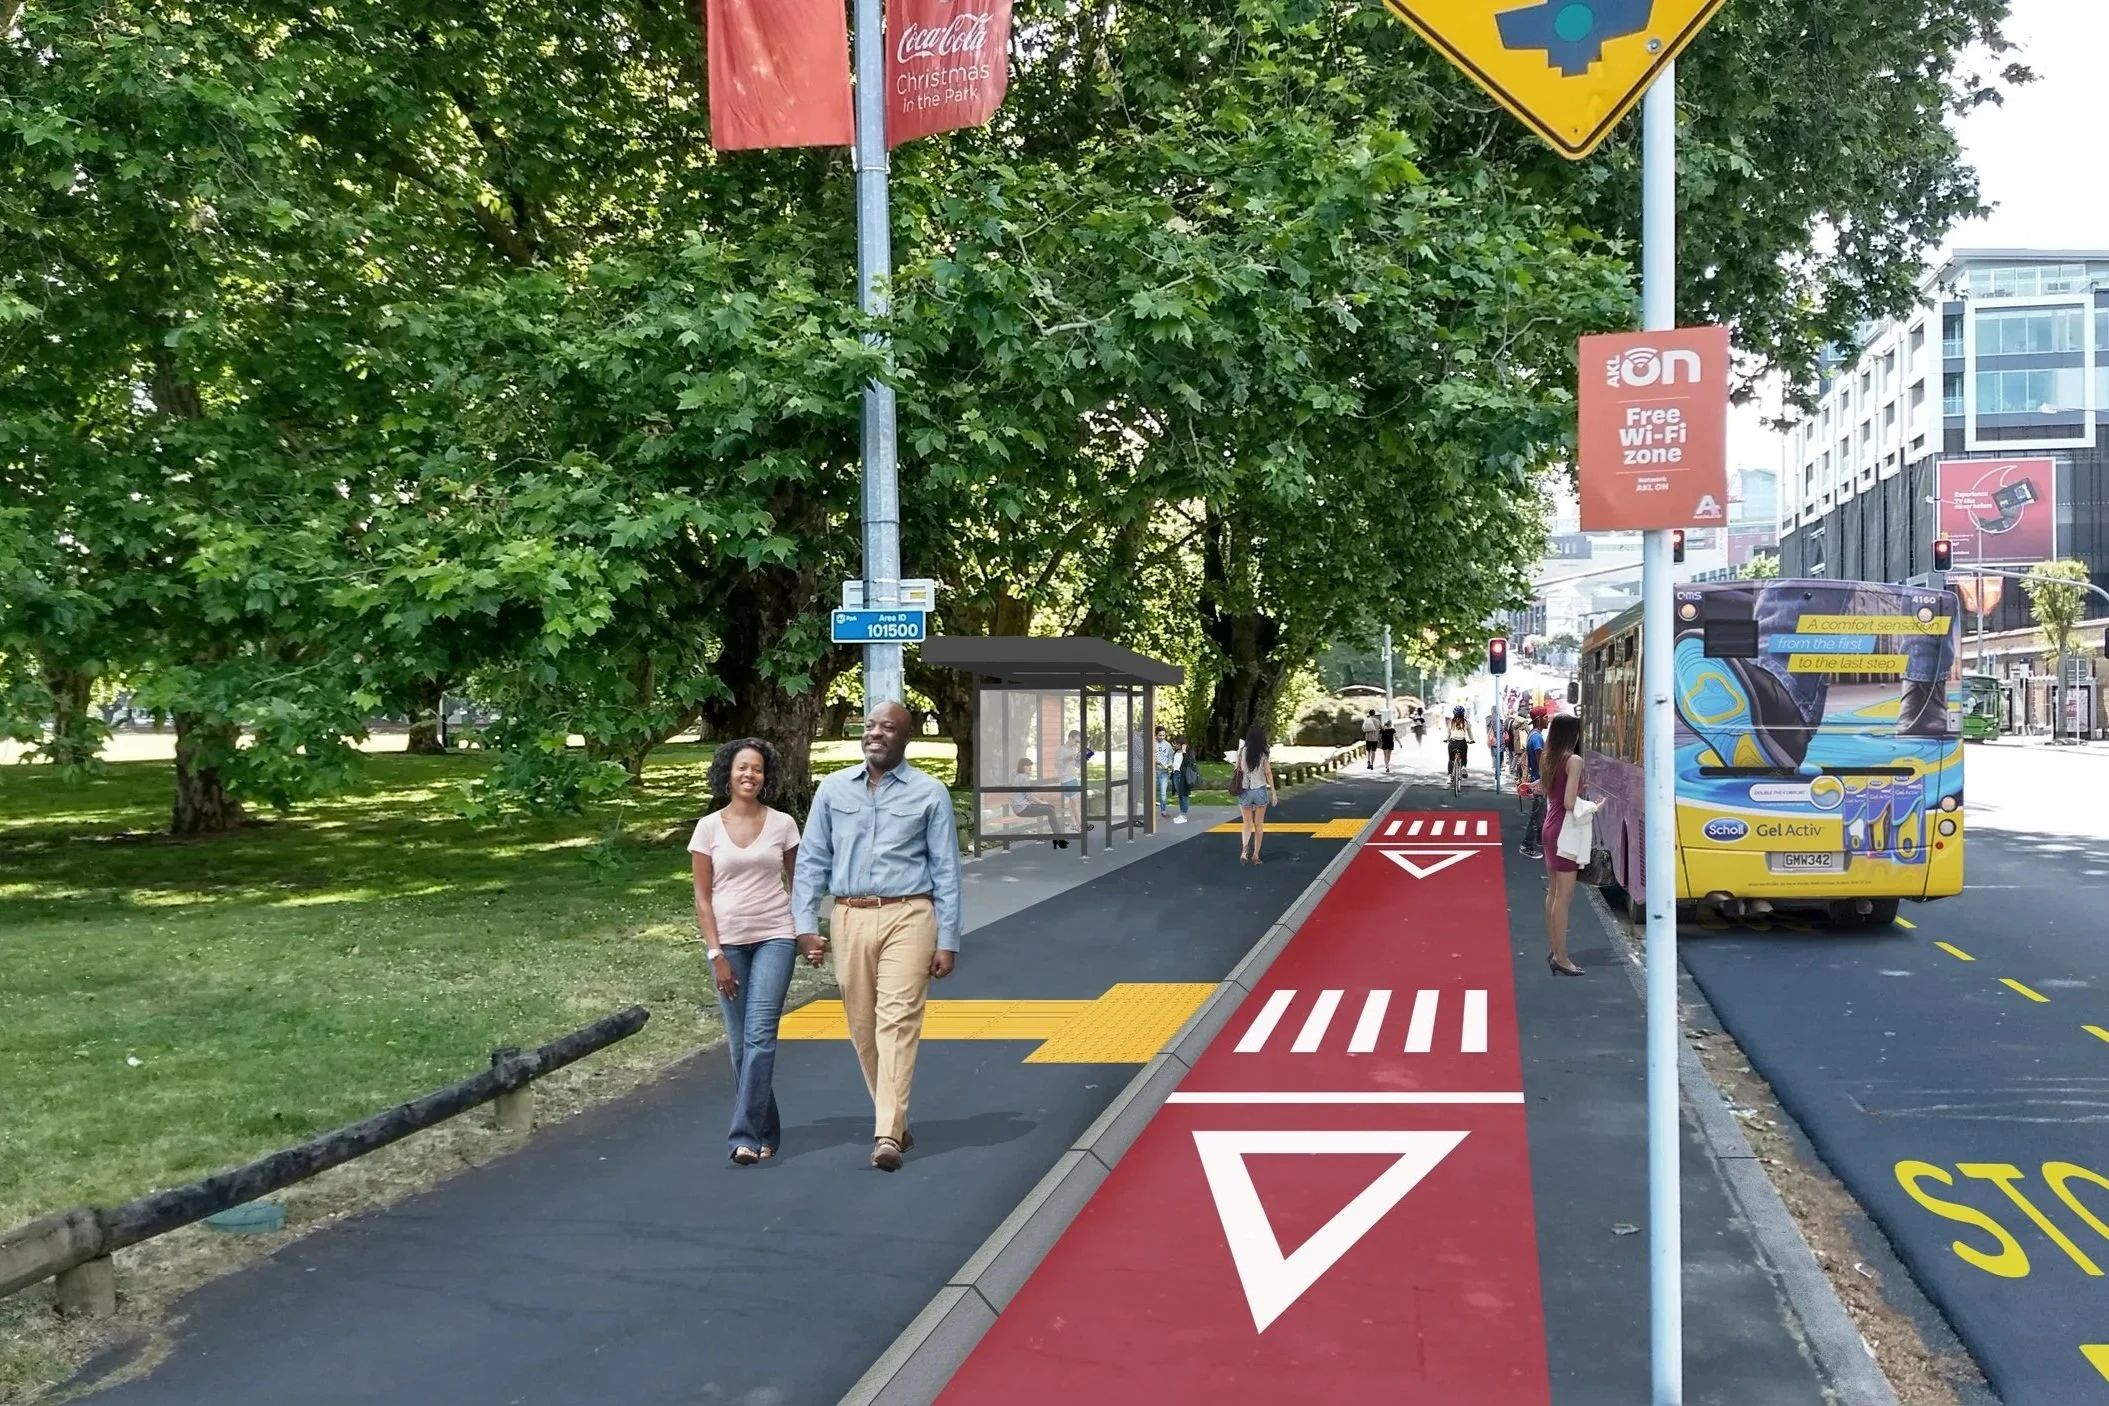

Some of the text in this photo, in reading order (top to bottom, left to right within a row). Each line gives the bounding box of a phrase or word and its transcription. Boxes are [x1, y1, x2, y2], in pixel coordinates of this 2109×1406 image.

[897, 64, 990, 95] Christmas
[903, 84, 978, 113] in the Park
[1606, 355, 1620, 388] AKL
[1626, 407, 1681, 426] Free
[1619, 423, 1687, 446] Wi-Fi
[1624, 447, 1682, 465] zone
[1912, 595, 1936, 604] 4160
[879, 614, 896, 622] Area
[1807, 618, 1940, 631] A comfort sensation
[867, 623, 918, 638] 101500
[1777, 637, 1863, 650] from the first
[1799, 657, 1896, 670] to the last step
[1709, 824, 1822, 836] Scholl Gel Activ
[1785, 854, 1830, 865] GMW342
